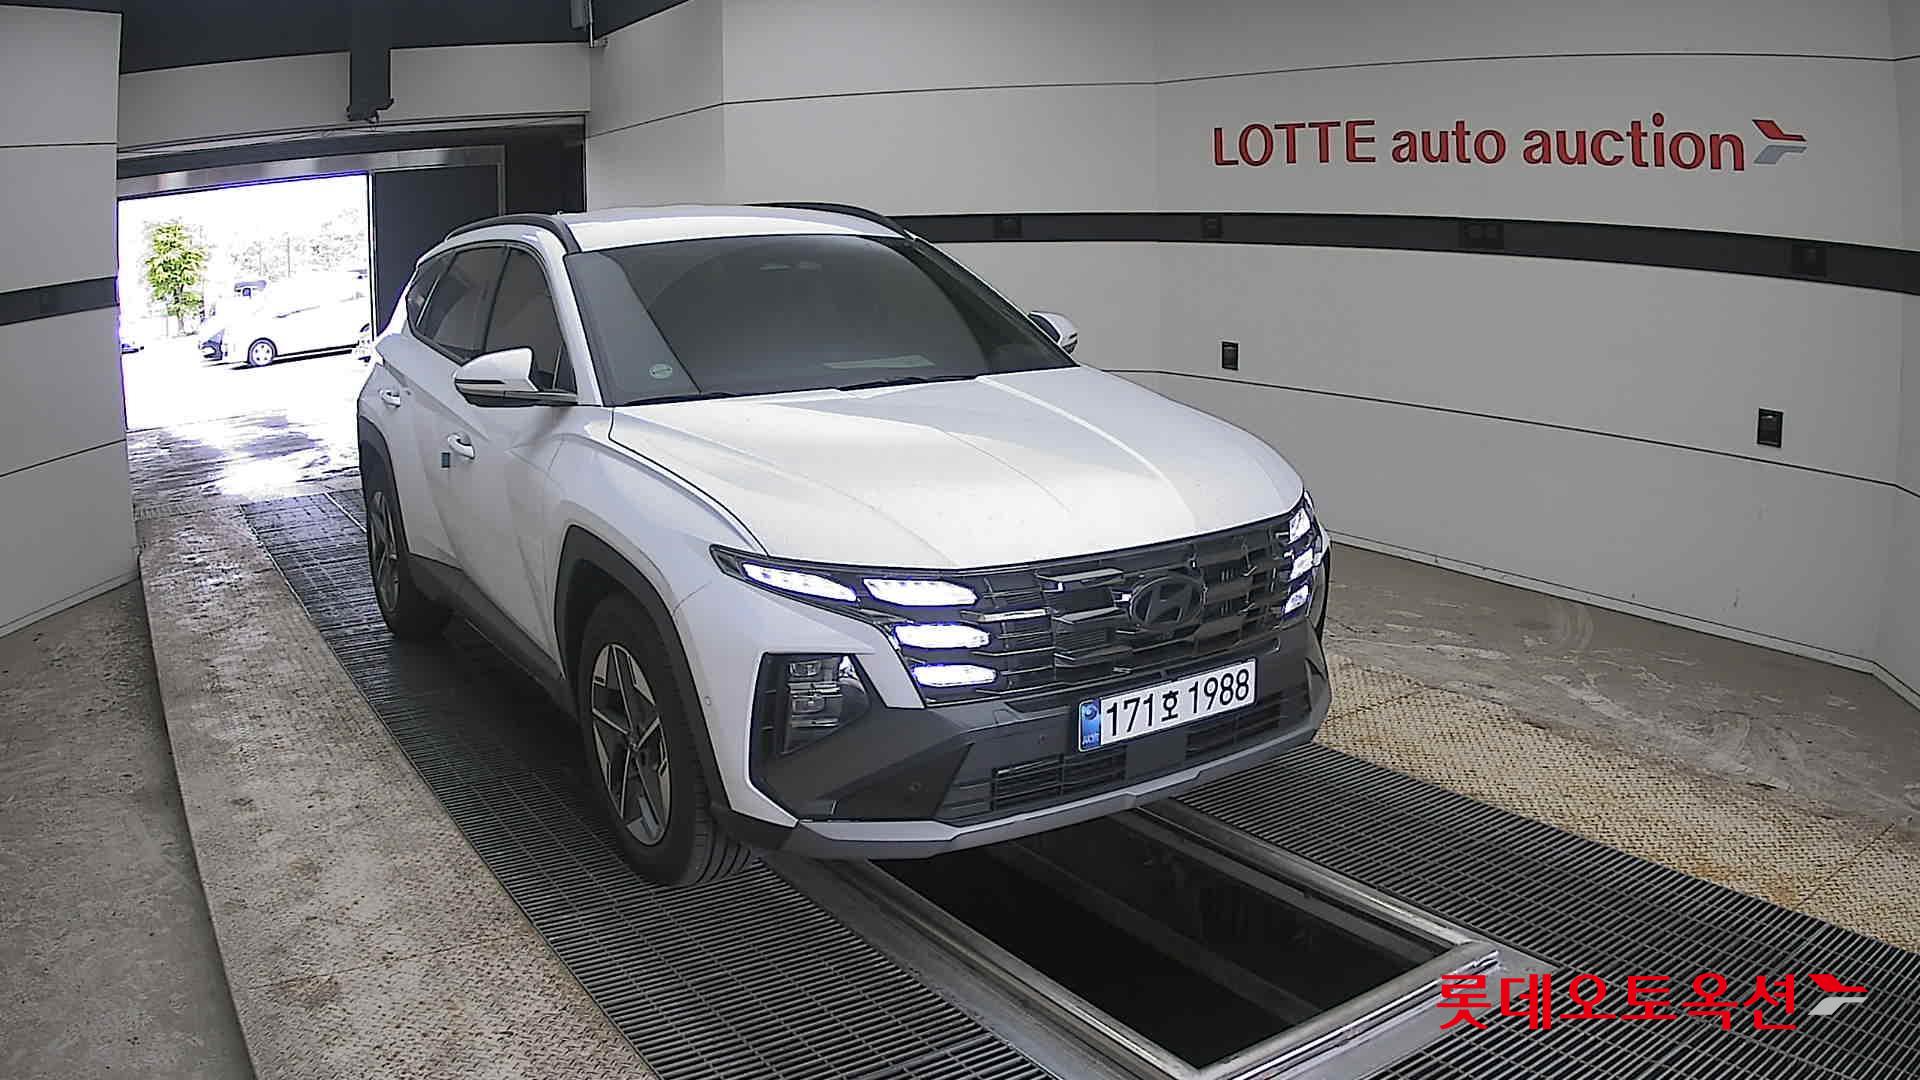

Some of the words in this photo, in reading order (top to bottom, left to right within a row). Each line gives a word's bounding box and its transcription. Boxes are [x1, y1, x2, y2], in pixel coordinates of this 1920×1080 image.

[1213, 120, 1377, 166] LOTTE
[1391, 120, 1508, 165] auto
[1522, 112, 1746, 172] auction
[1106, 690, 1179, 737] 171호
[1188, 668, 1250, 714] 1988
